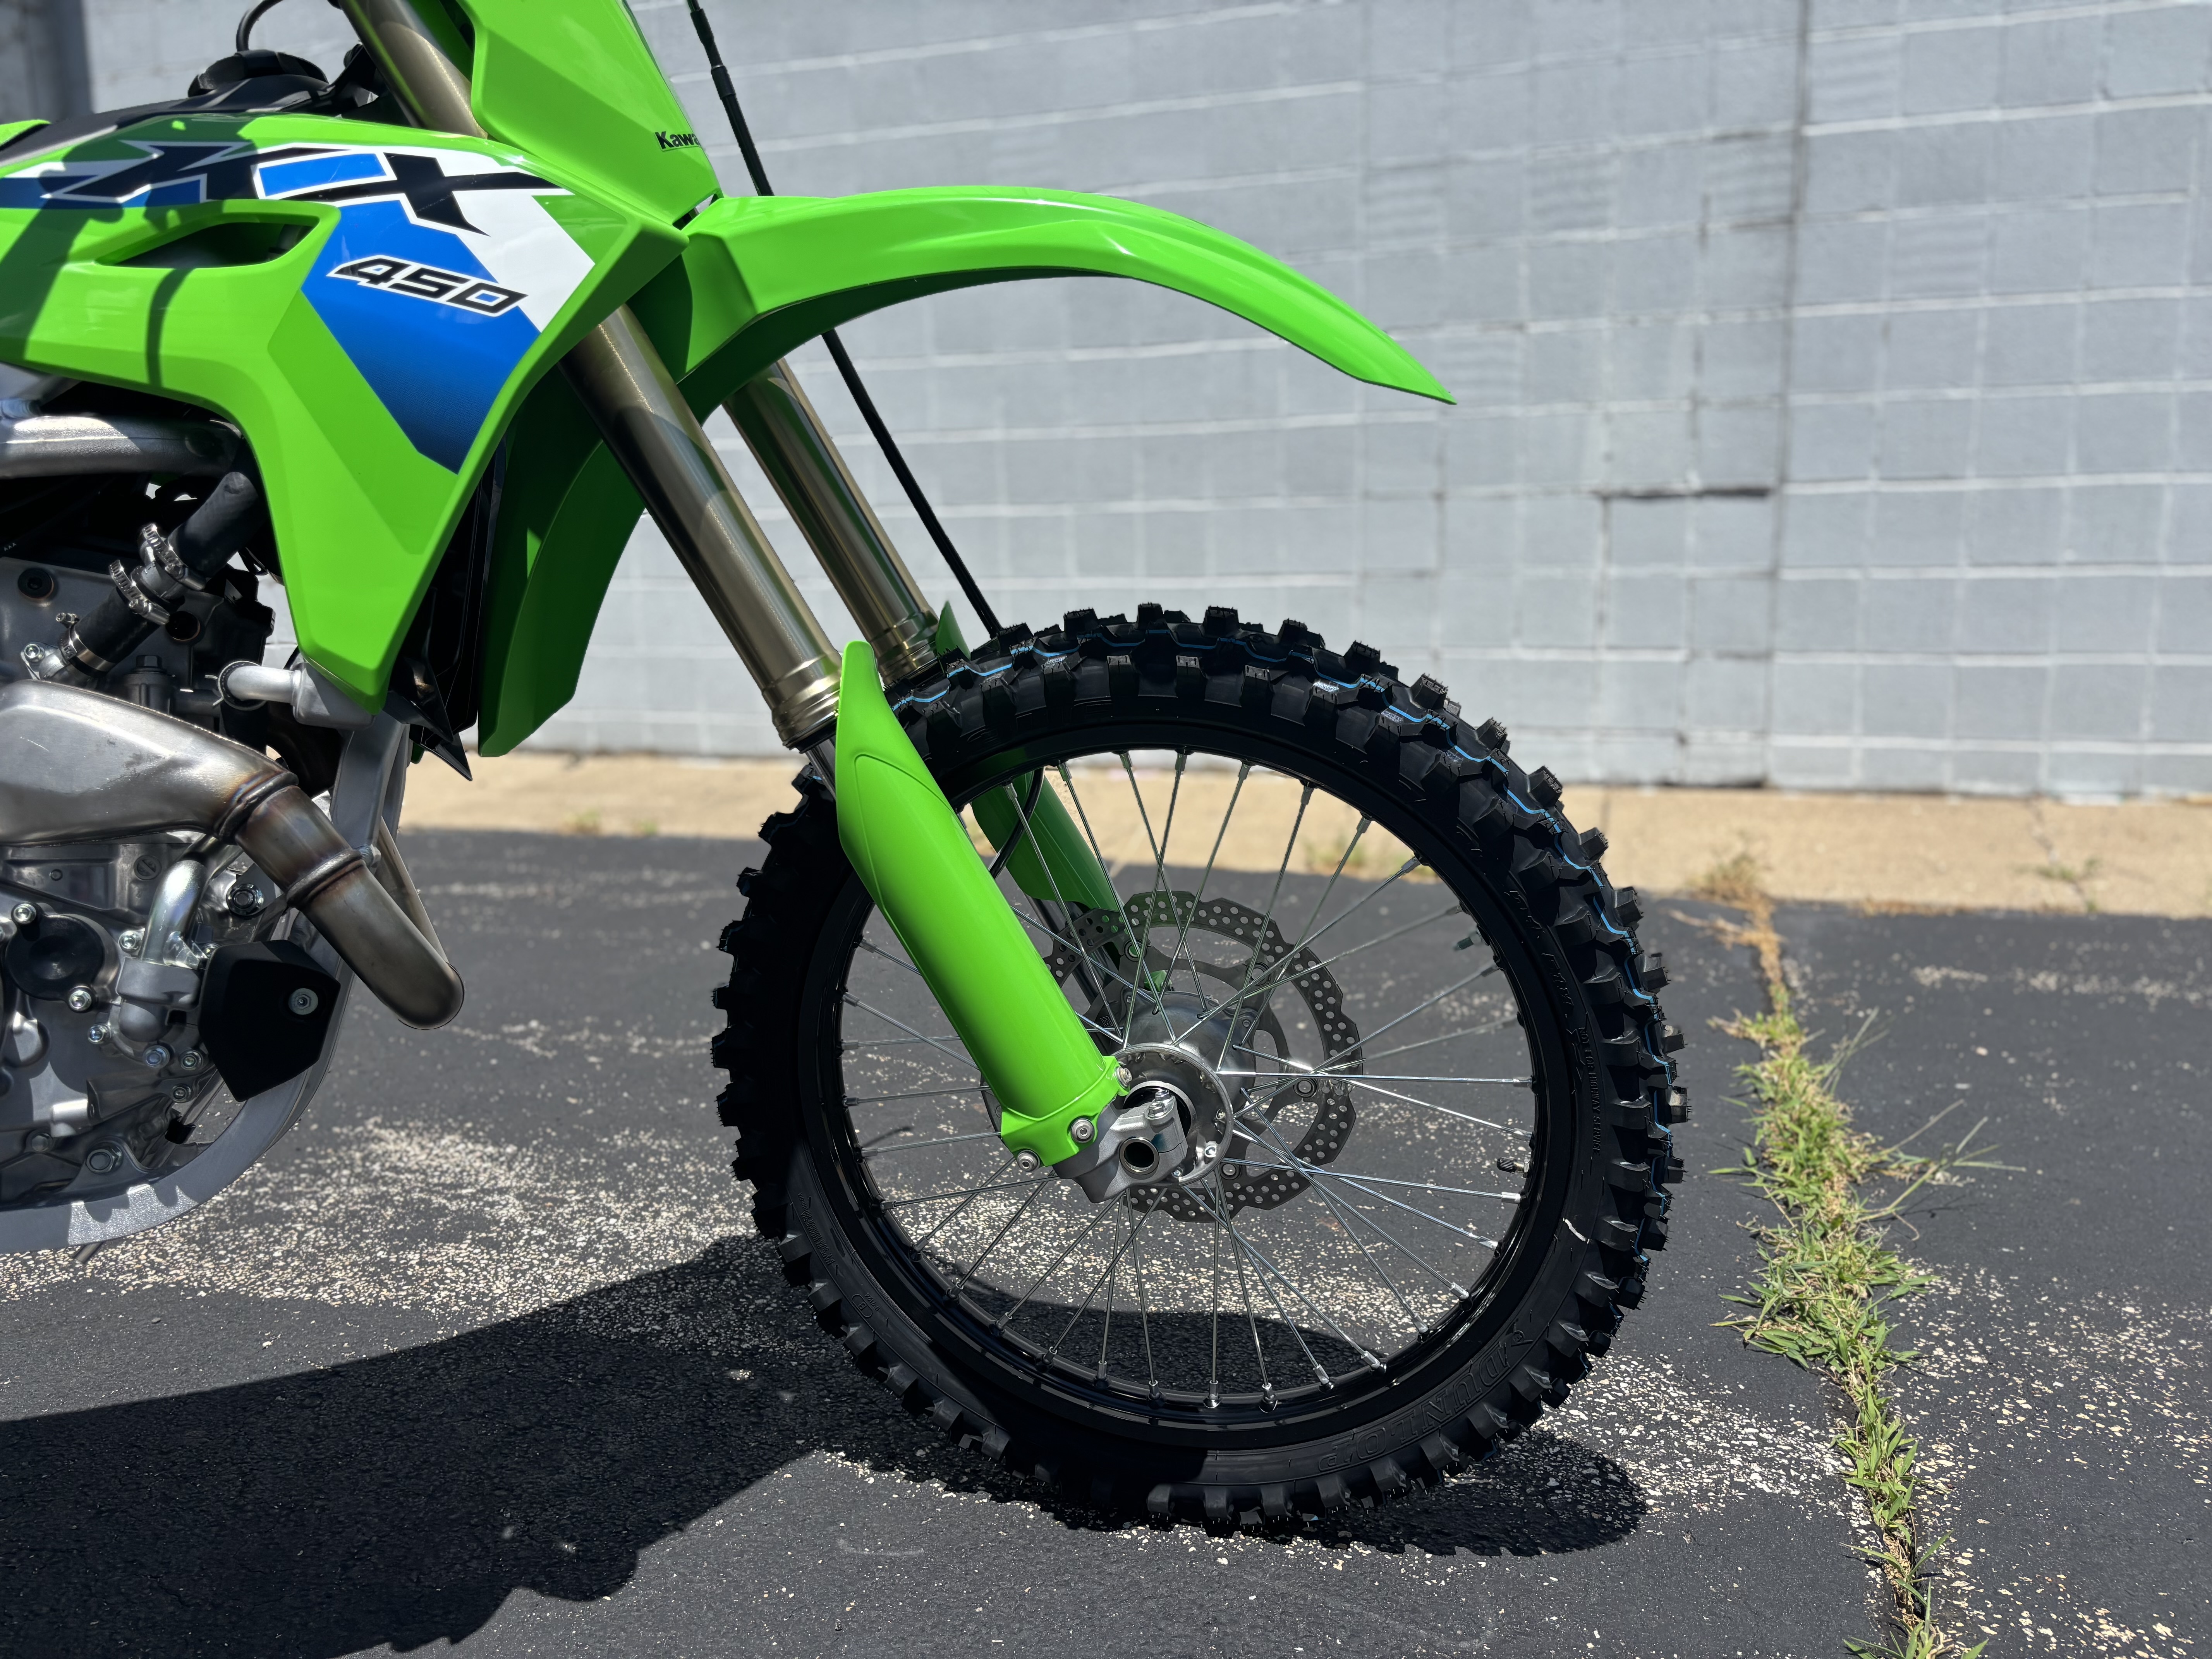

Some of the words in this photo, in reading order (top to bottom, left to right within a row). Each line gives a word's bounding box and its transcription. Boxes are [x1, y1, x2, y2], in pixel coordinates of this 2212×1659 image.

[332, 257, 529, 314] 450
[1578, 1027, 1590, 1044] NOT
[1588, 1072, 1601, 1113] HIGHWAY
[1592, 1115, 1602, 1156] SERVICE
[1319, 1342, 1511, 1472] DUNLOP
